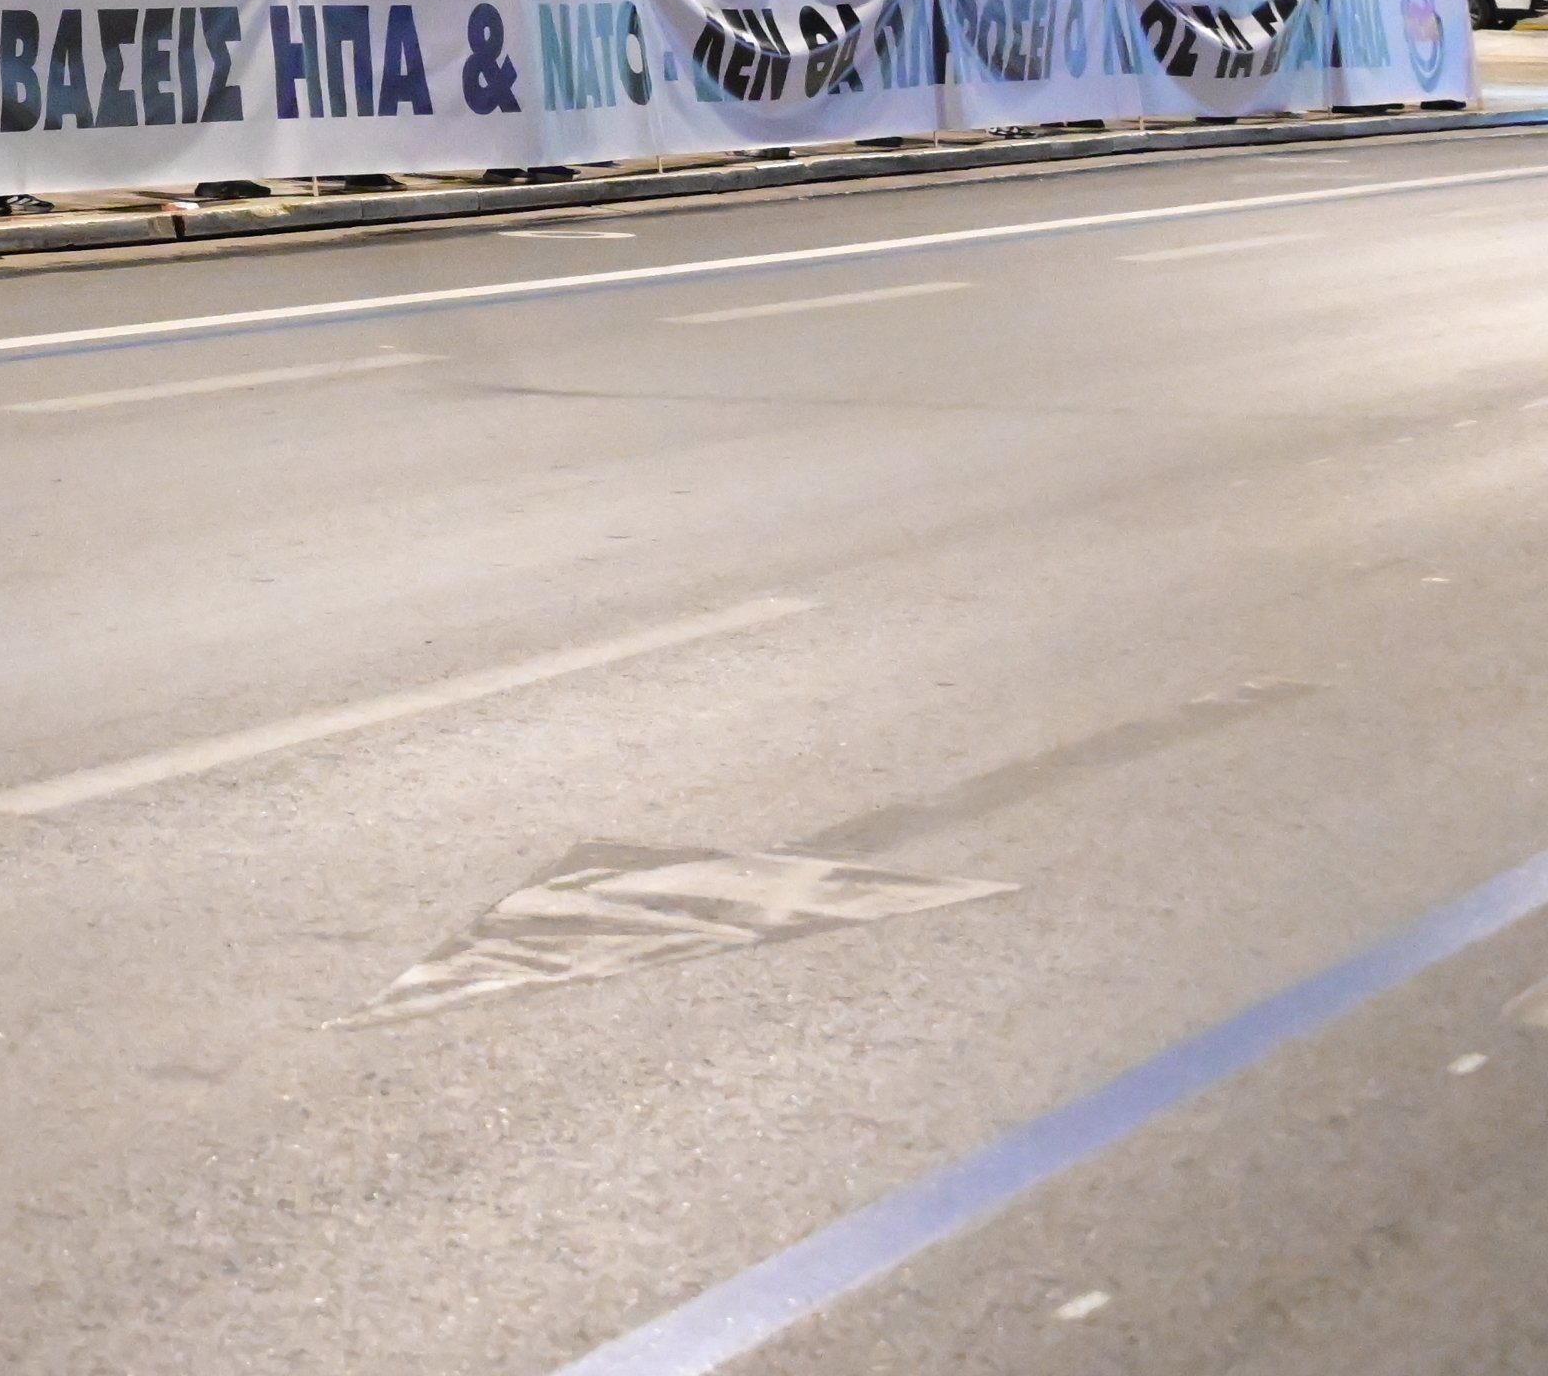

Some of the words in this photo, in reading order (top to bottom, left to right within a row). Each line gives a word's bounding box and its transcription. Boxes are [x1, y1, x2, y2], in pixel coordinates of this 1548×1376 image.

[0, 6, 244, 133] ΒΑΣΕΙΣ
[269, 4, 433, 120] ΗΠΑ
[462, 2, 522, 116] &
[538, 0, 653, 112] ΝΑΤΟ
